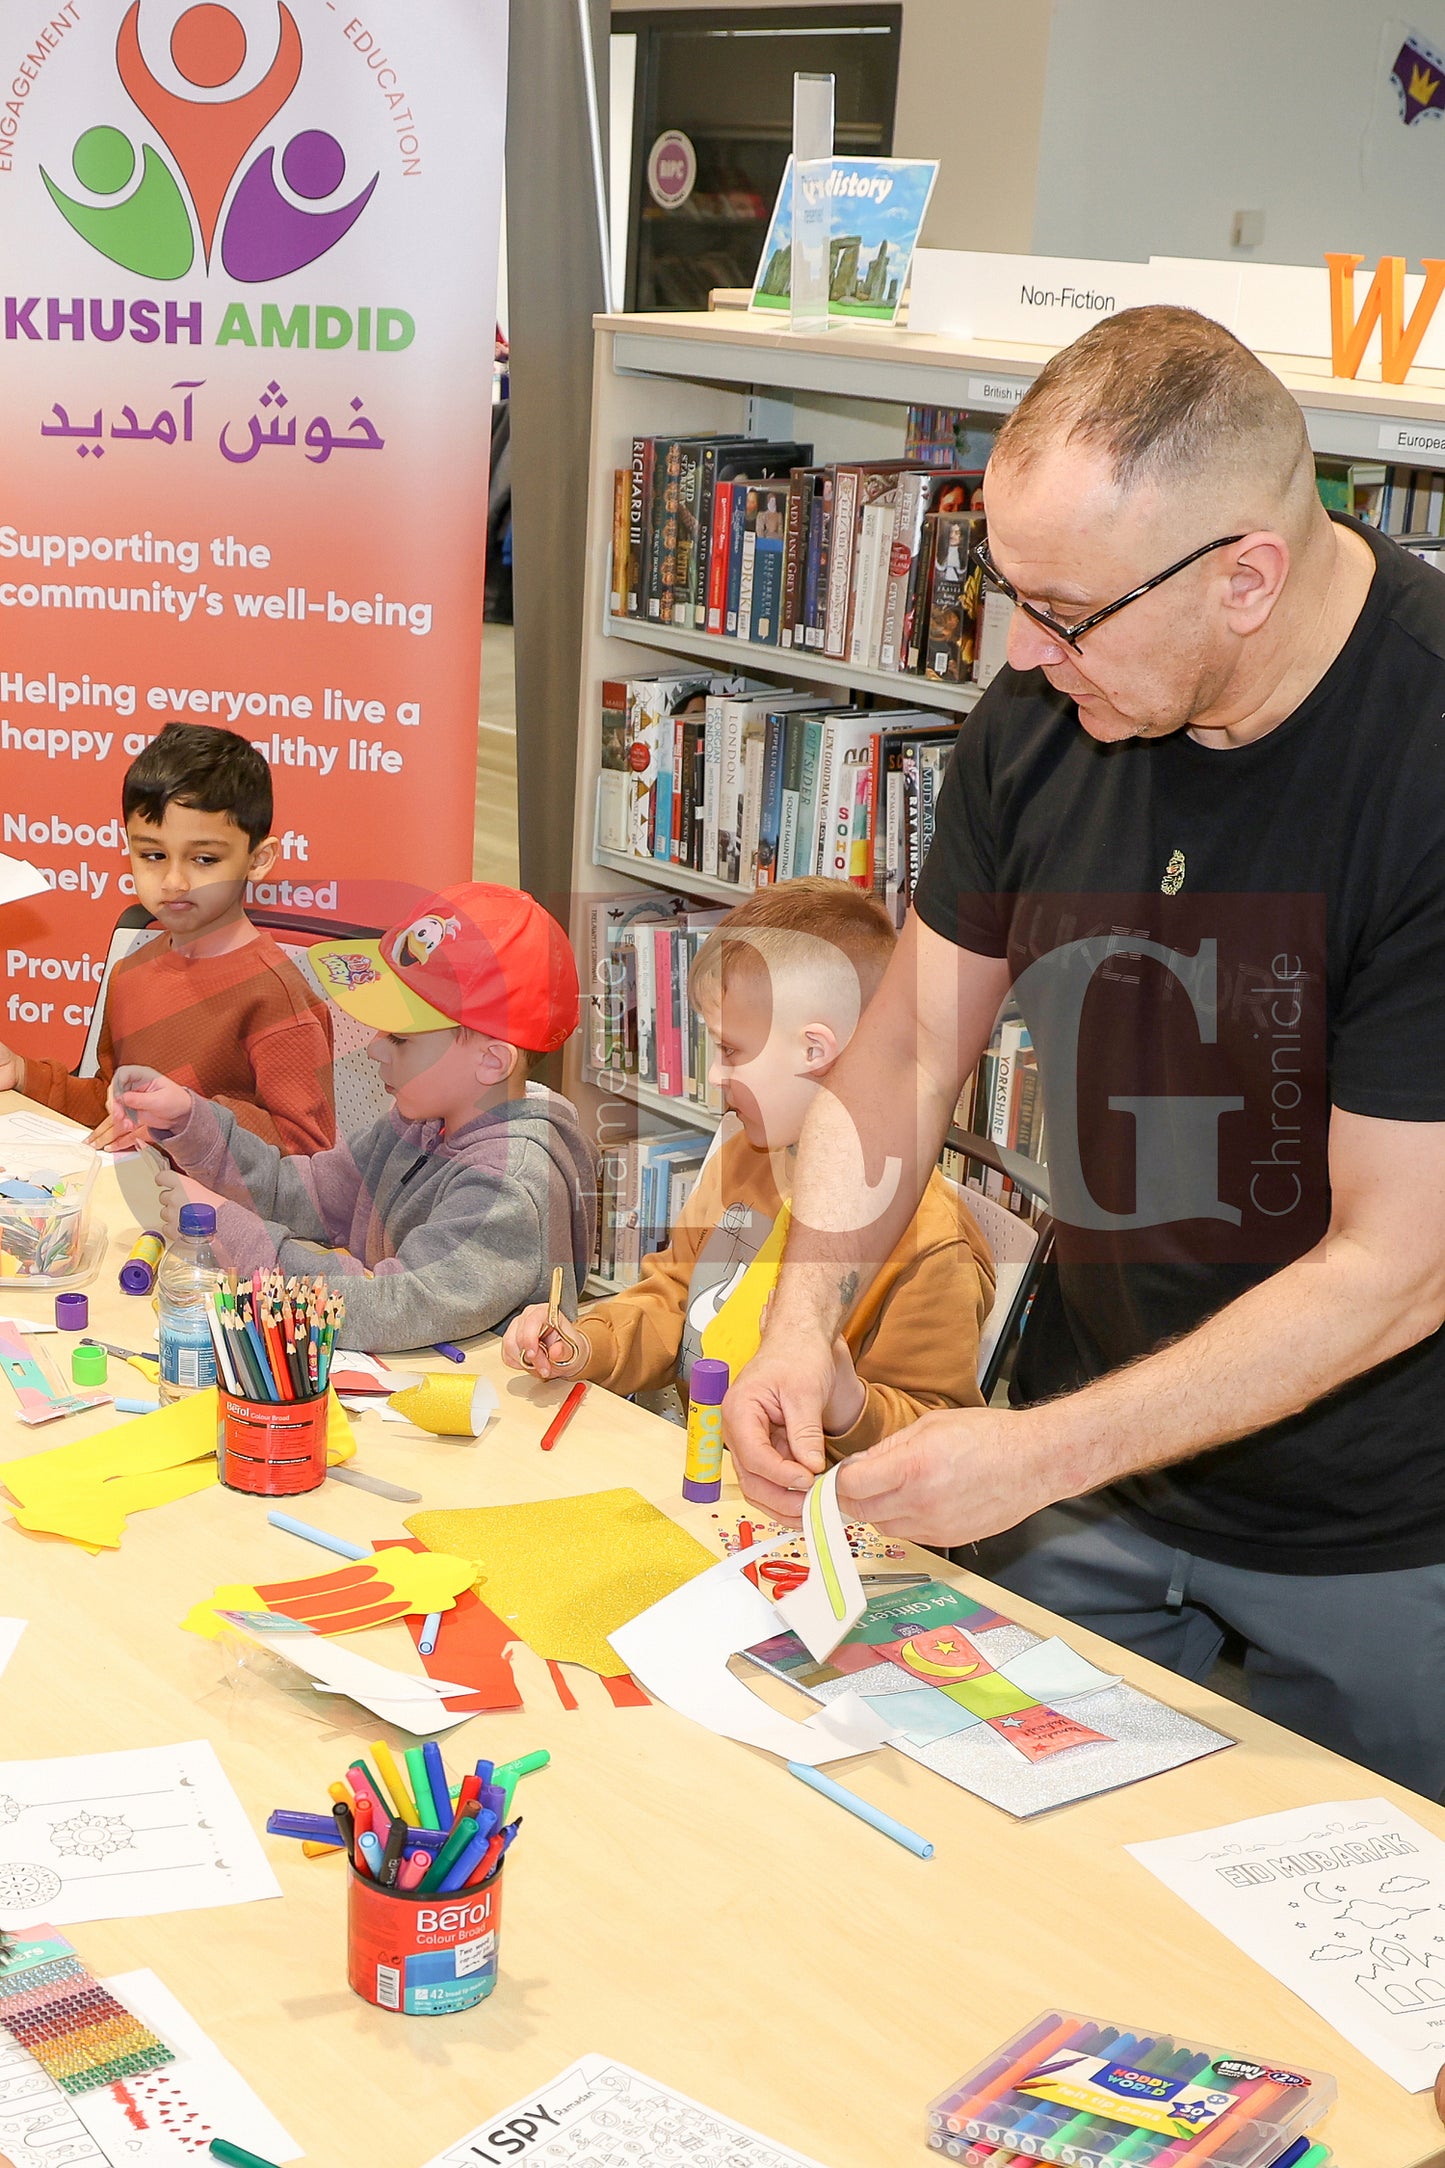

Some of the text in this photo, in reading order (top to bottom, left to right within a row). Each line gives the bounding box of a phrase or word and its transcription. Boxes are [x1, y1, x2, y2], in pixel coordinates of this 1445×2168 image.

[0, 2, 81, 172] ENGAGEMENT
[343, 17, 422, 177] EDUCATION
[1020, 285, 1116, 312] Non-Fiction
[4, 297, 416, 352] KHUSH AMDID
[984, 385, 1012, 399] British
[219, 380, 386, 464] خوش
[630, 441, 644, 544] RICHARD III
[686, 461, 696, 502] DAVID
[790, 495, 801, 526] LADY
[901, 492, 912, 531] PETER
[0, 526, 271, 573] Supporting the
[788, 530, 799, 559] JANE
[786, 562, 797, 594] GREY
[234, 588, 434, 636] well-being
[884, 583, 897, 643] CIVIL WAR
[0, 672, 420, 726] Helping everyone live a
[0, 720, 114, 761] happy
[348, 739, 403, 774] life
[713, 707, 722, 763] GEORGIAN
[727, 715, 737, 784] LONDON
[770, 722, 780, 767] ZEPPELIN
[801, 728, 816, 805] OUTSIDER
[821, 729, 834, 806] LEN GOODMAN
[909, 796, 918, 826] RAY
[781, 796, 793, 875] SQUARE HAUNTING
[834, 807, 850, 870] SOHO
[7, 994, 53, 1024] for
[993, 1056, 1011, 1134] YORKSHIRE
[226, 1401, 250, 1417] Berol
[868, 1594, 958, 1623] A4 Glitter
[1216, 1832, 1420, 1888] EID MUBARAK
[416, 1893, 492, 1933] Berol
[416, 1923, 487, 1945] Colour Broad
[430, 1989, 444, 1999] 42
[1107, 2075, 1168, 2097] WORLD
[1113, 2068, 1175, 2090] HOBBY
[487, 2104, 561, 2156] SPY
[554, 2090, 597, 2117] Ramadan
[1092, 2096, 1116, 2110] tip
[1118, 2101, 1162, 2122] pens
[1179, 2105, 1205, 2117] 30
